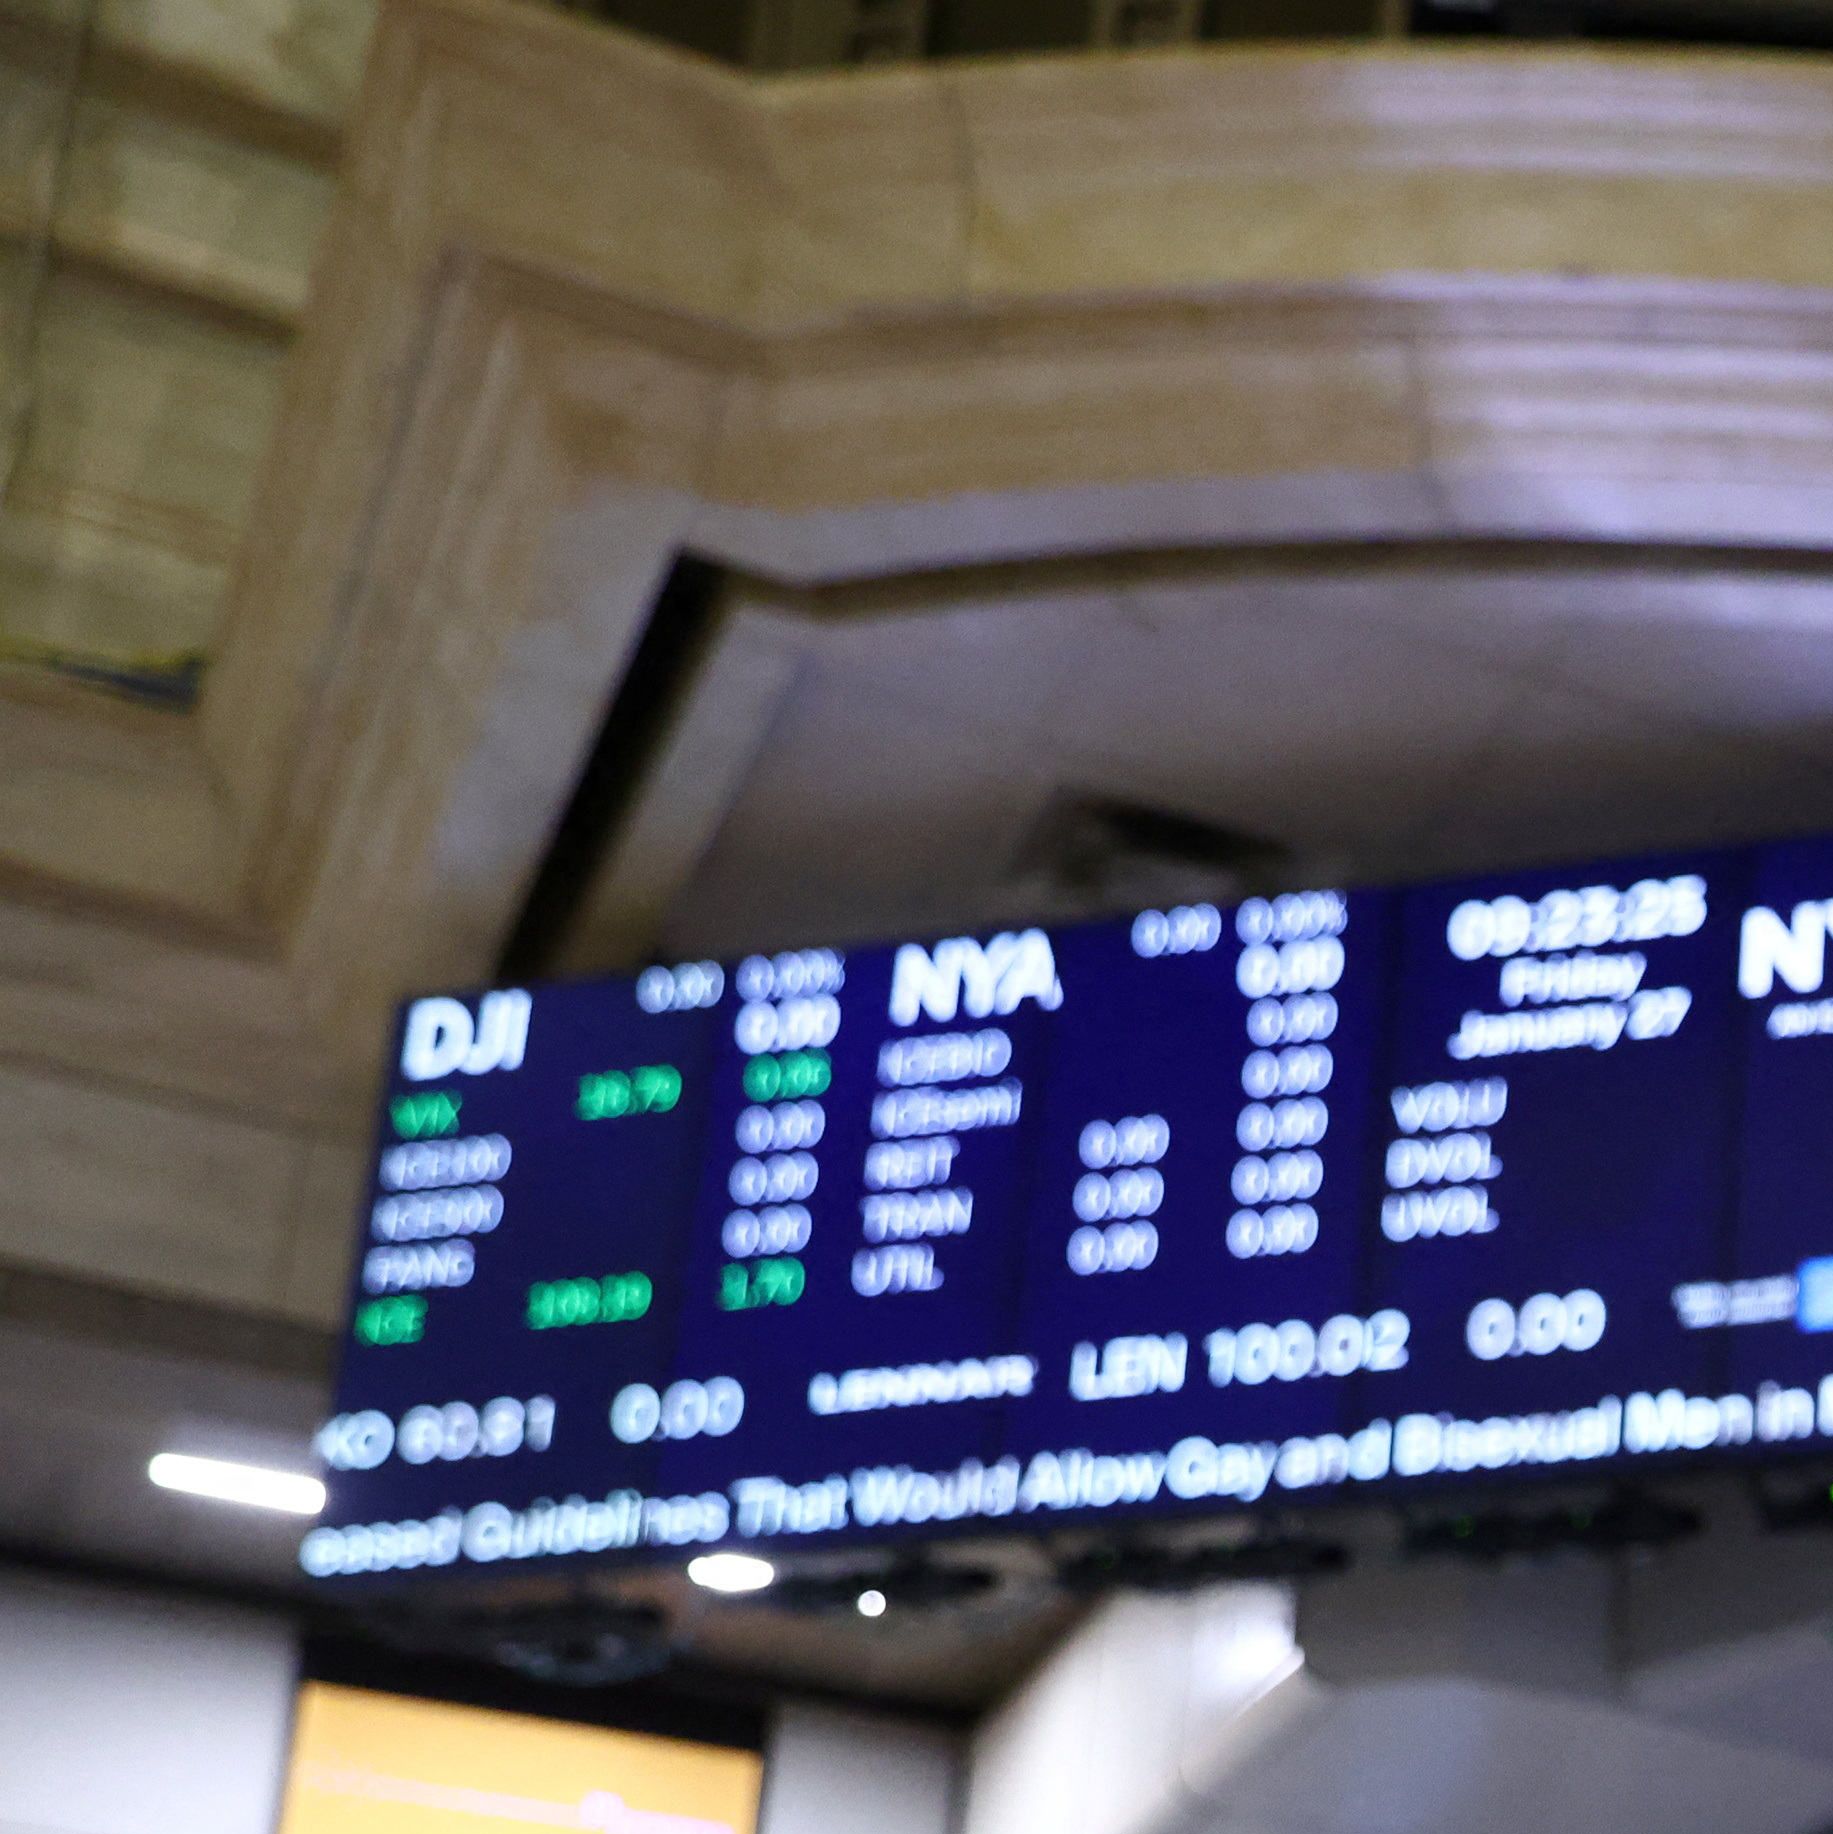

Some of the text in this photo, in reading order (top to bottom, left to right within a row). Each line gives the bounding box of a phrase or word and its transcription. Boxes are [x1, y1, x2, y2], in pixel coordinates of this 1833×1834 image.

[1131, 902, 1221, 958] 0.00
[888, 927, 1063, 1027] NYA
[1498, 950, 1648, 1008] Friday
[401, 988, 533, 1081] DJI
[1246, 991, 1340, 1049] 0.00
[1446, 985, 1693, 1060] January 27
[1241, 1043, 1334, 1099] 0.00
[734, 1097, 827, 1155] 0.00
[1077, 1113, 1170, 1170] 0.00
[1236, 1095, 1329, 1153] 0.00
[728, 1150, 820, 1207] 0.00
[1072, 1166, 1165, 1223] 0.00
[1230, 1148, 1324, 1205] 0.00
[720, 1203, 813, 1260] 0.00
[1066, 1218, 1160, 1277] 0.00
[1225, 1201, 1320, 1260] 0.00
[609, 1374, 745, 1445] 0.00
[1068, 1330, 1188, 1402] LEN
[1204, 1307, 1411, 1388] 100.02
[1466, 1287, 1607, 1362] 0.00
[459, 1487, 731, 1564] Guidelines
[727, 1472, 850, 1540] That
[848, 1456, 1023, 1529] Would
[1022, 1446, 1168, 1512] Allow
[1163, 1435, 1278, 1505] Gay
[1273, 1417, 1394, 1482] and
[1392, 1392, 1622, 1478] Bisexual
[1622, 1387, 1754, 1450] Men
[1755, 1378, 1816, 1443] in
